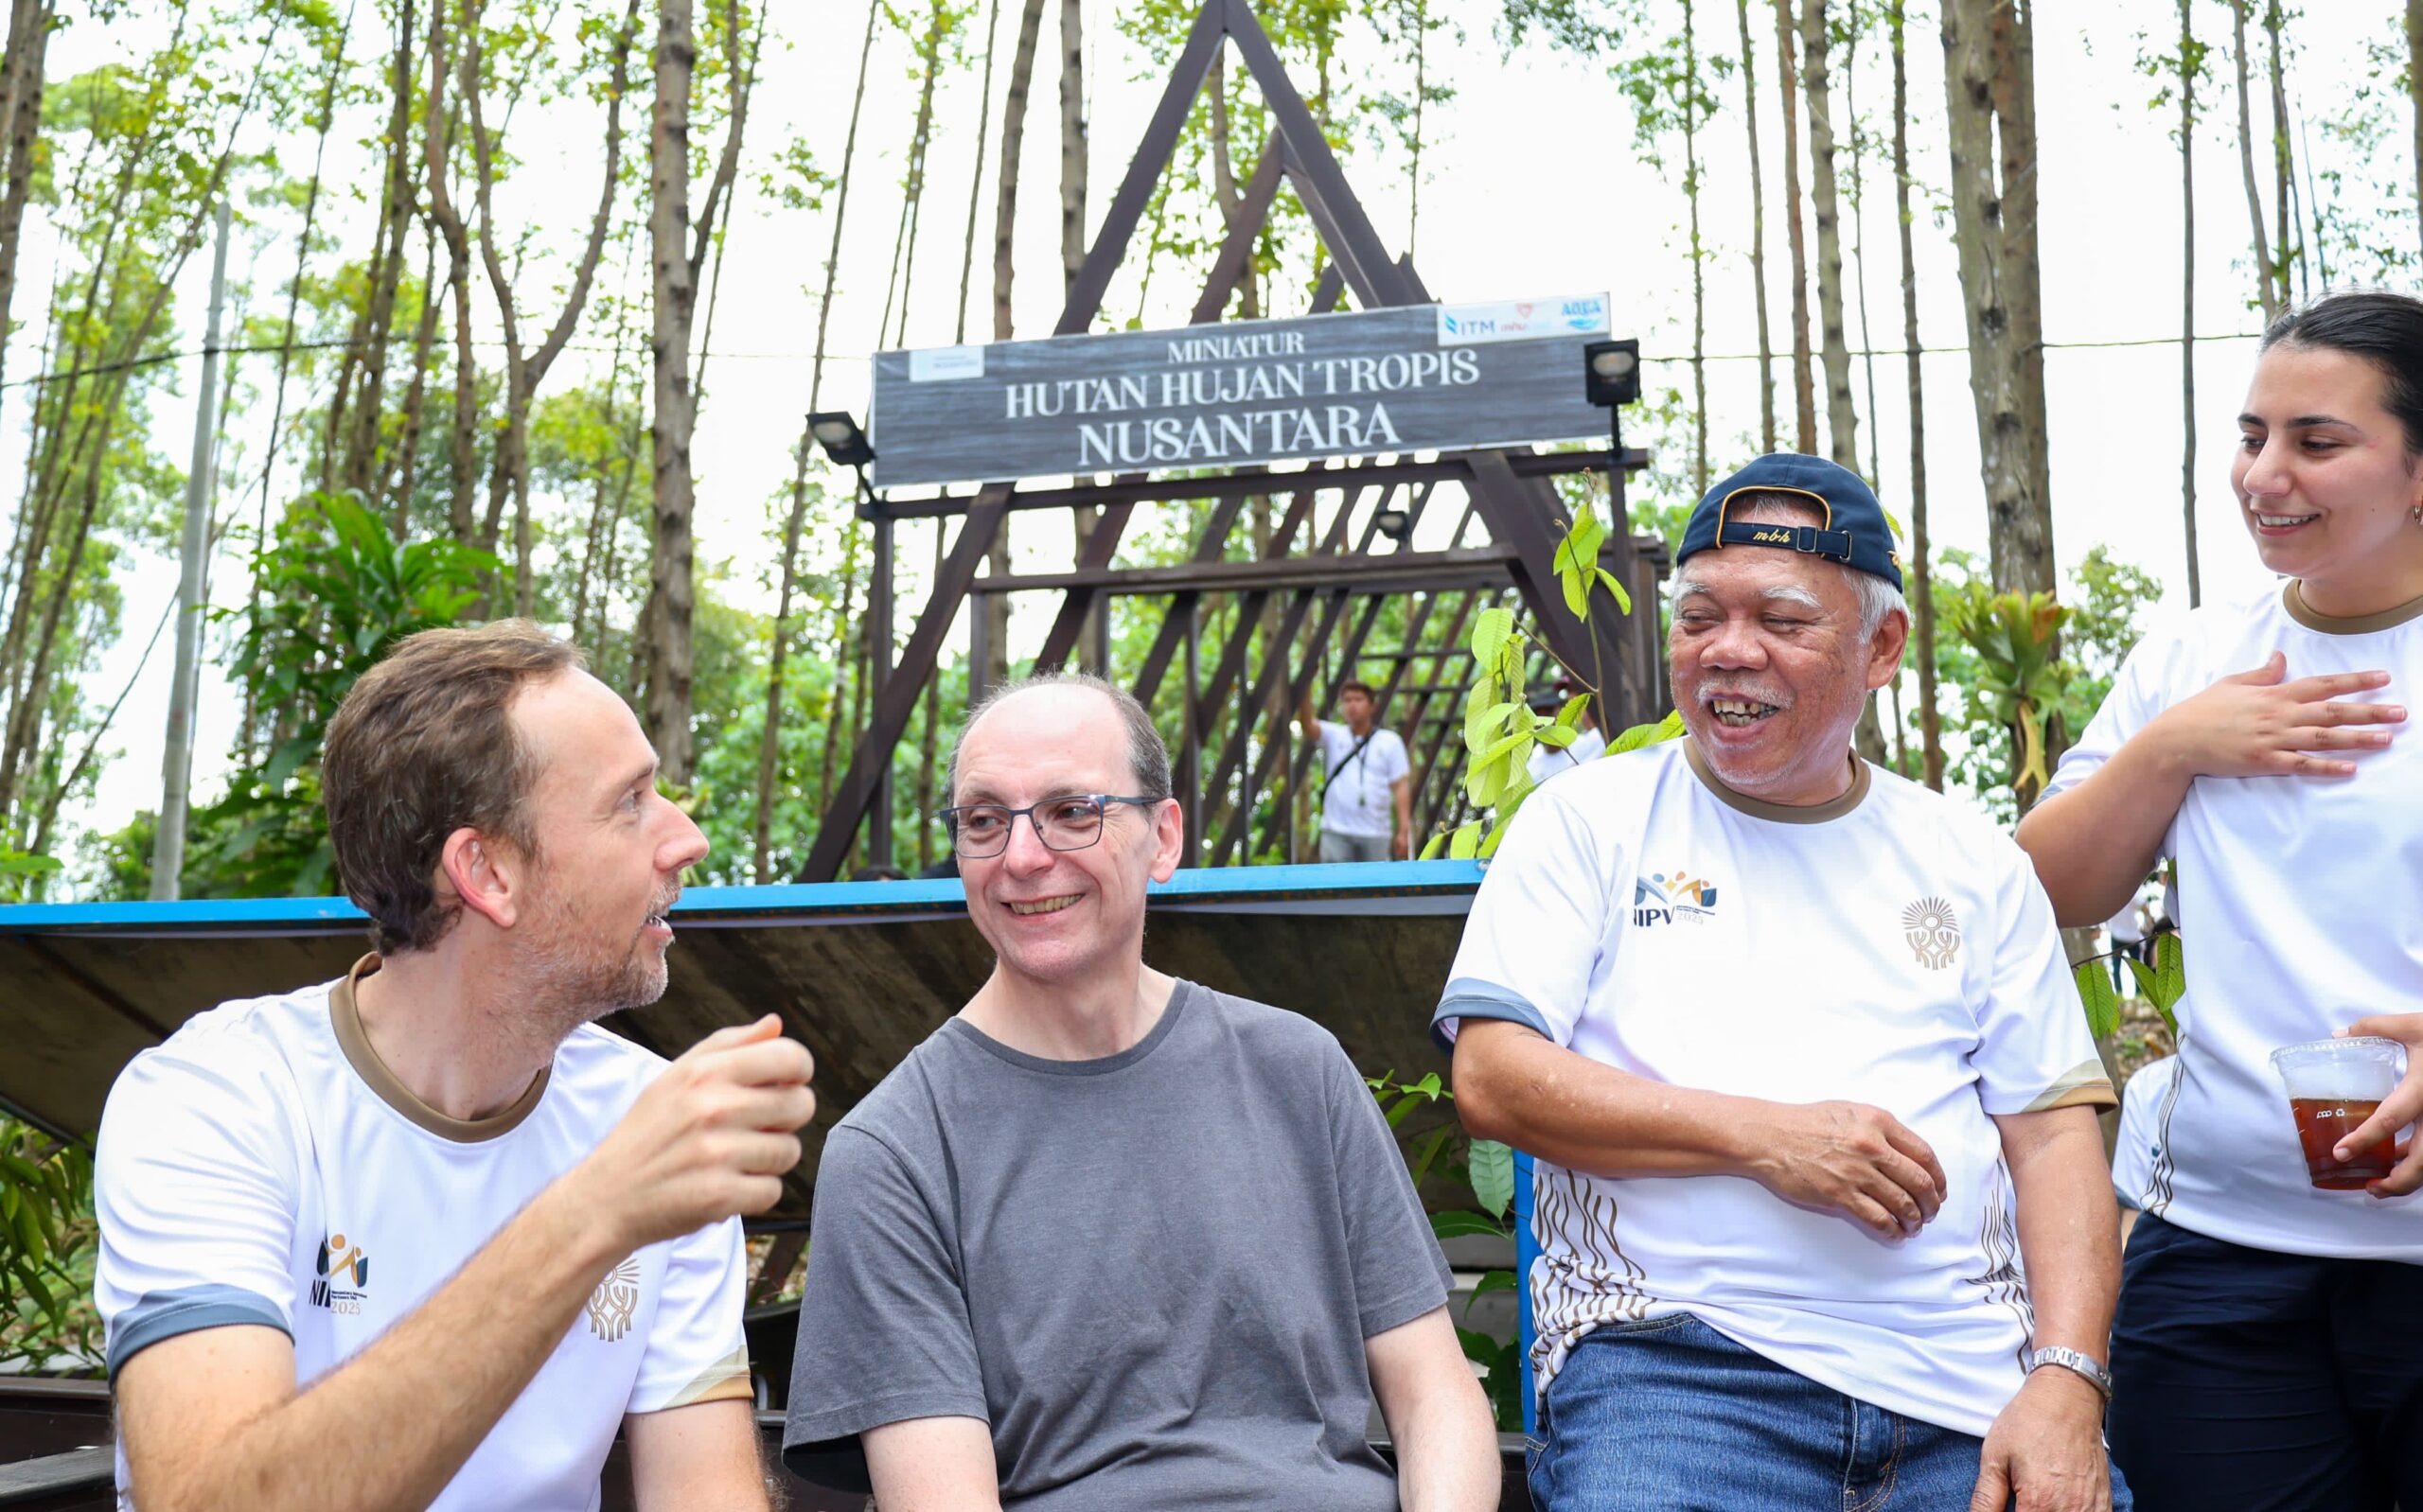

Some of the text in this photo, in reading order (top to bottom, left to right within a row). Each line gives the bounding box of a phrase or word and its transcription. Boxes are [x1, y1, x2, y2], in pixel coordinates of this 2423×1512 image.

[1168, 332, 1305, 364] MINIATUR
[1461, 320, 1495, 336] ITM
[1005, 348, 1480, 419] HUTAN HUJAN TROPIS
[1077, 401, 1403, 466] NUSANTARA
